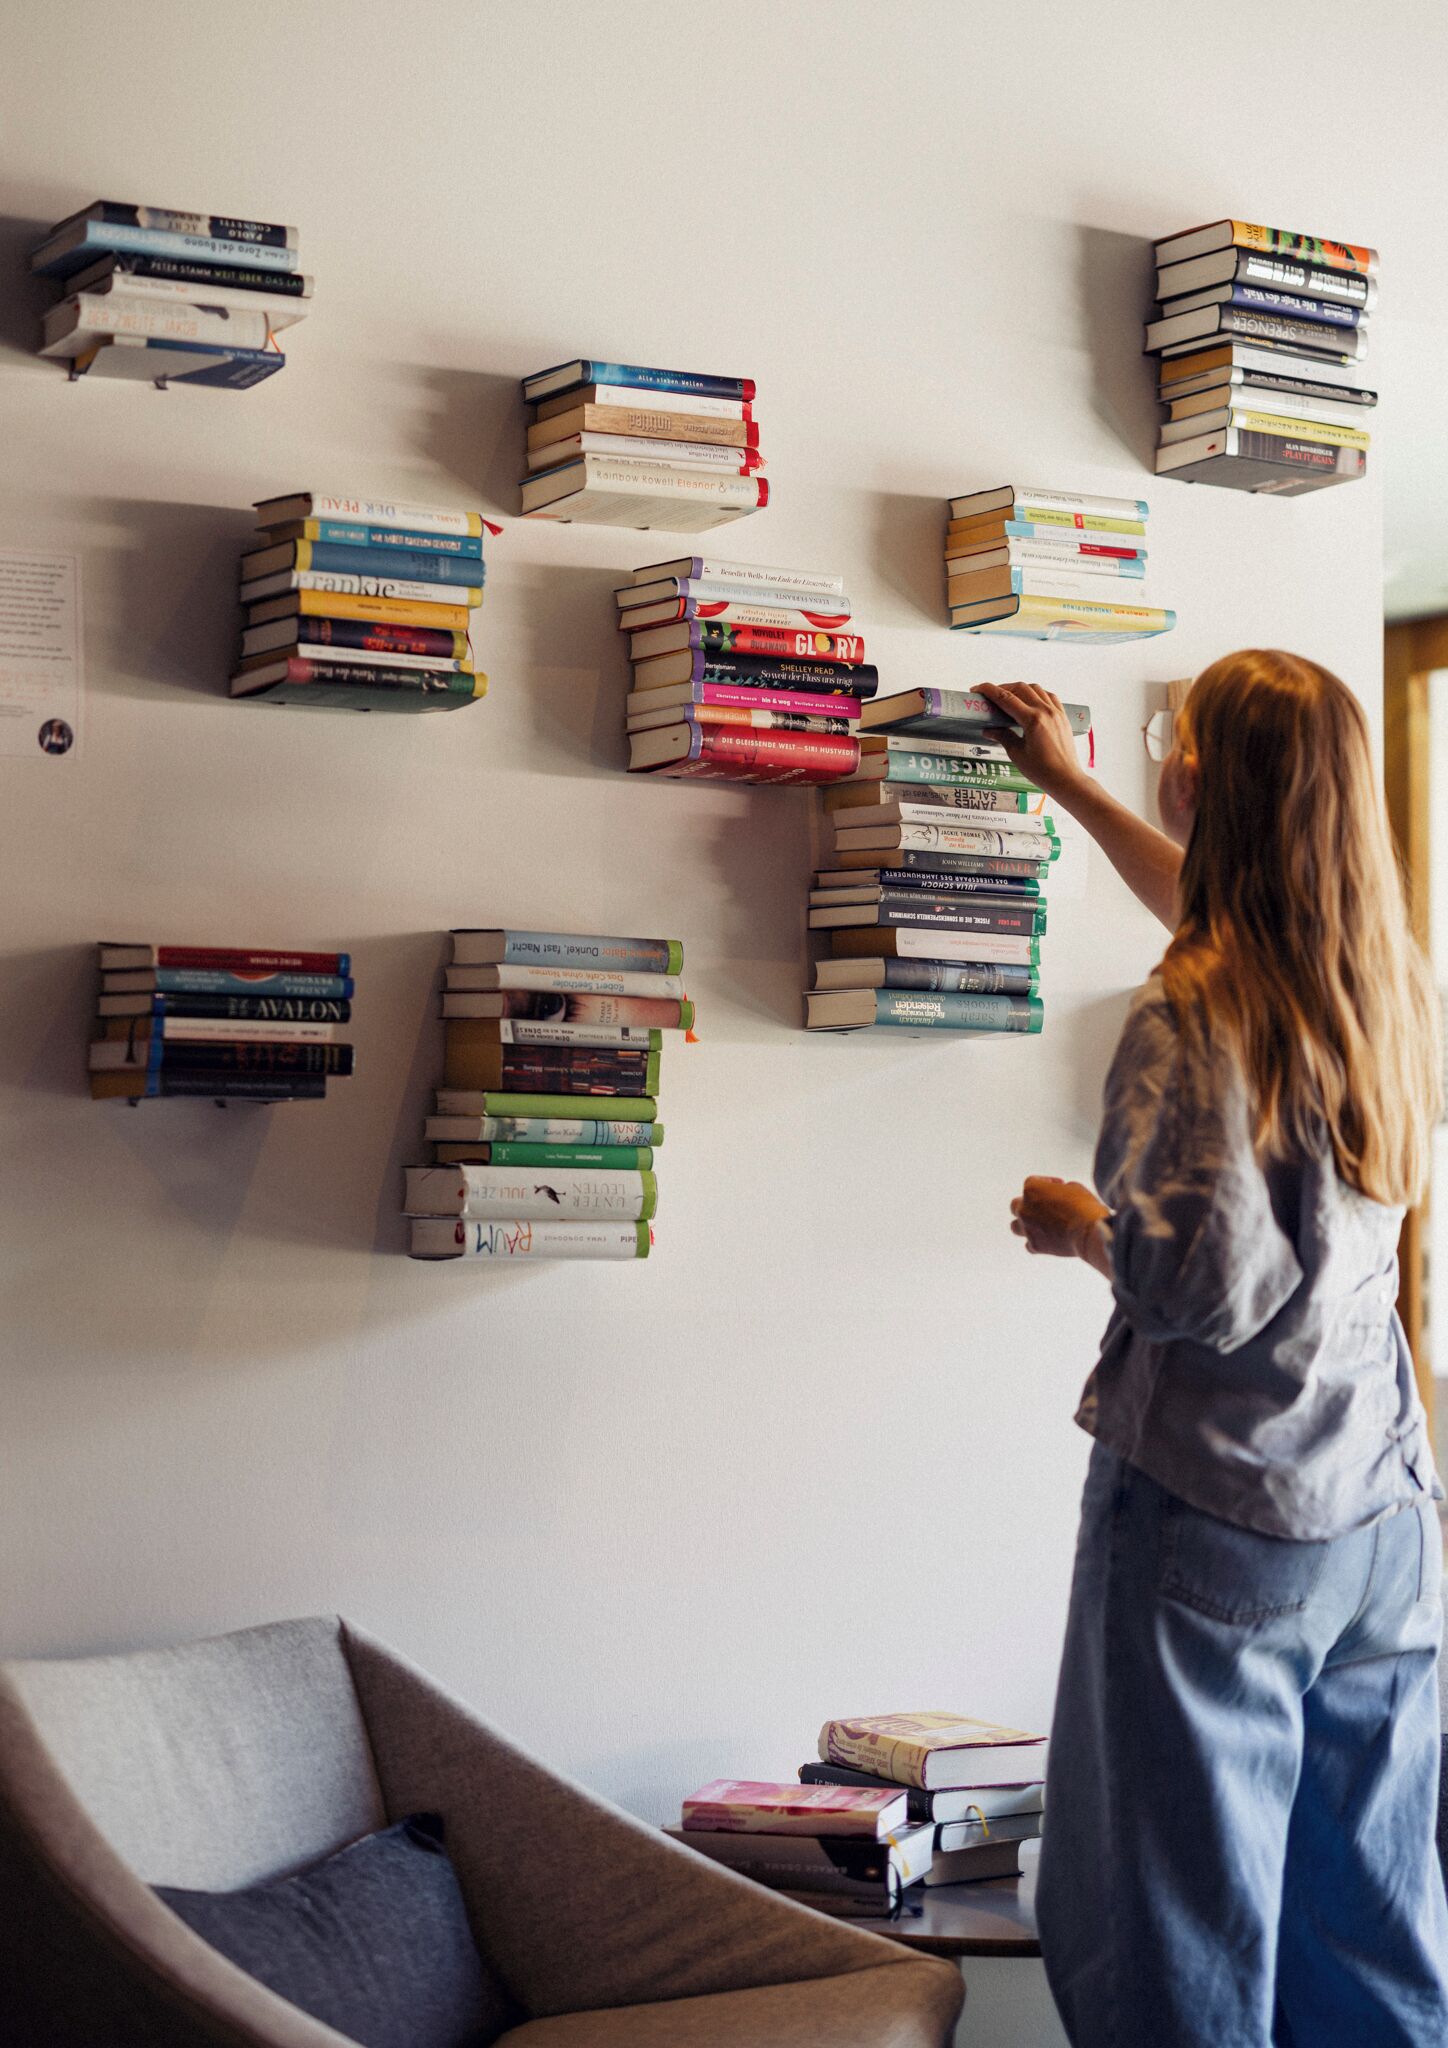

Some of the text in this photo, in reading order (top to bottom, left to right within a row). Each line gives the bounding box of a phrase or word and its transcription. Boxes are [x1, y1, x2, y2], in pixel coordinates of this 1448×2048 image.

[218, 218, 272, 235] COGNETTI
[228, 228, 263, 242] PAOLO
[236, 243, 261, 259] Zora
[149, 258, 181, 274] PETER
[180, 262, 212, 278] STAMM
[214, 266, 236, 280] WEIT
[1243, 288, 1265, 301] Wals
[1265, 291, 1280, 303] des
[1280, 296, 1301, 310] Tage
[1300, 300, 1317, 312] Die
[1232, 316, 1297, 341] SPRENGER
[638, 374, 705, 388] Alle sieben Wellen
[1294, 424, 1308, 434] DIE
[1284, 443, 1300, 451] ALAN
[710, 452, 730, 461] David
[1303, 452, 1311, 460] IT
[597, 470, 728, 494] Rainbow Rowell Eleanor &
[321, 496, 397, 518] DER PFAU
[1048, 554, 1066, 564] Leben
[720, 567, 748, 579] Benedict
[747, 570, 764, 581] Wells
[777, 574, 793, 585] Ende
[776, 592, 831, 606] ELENA FERRANTE
[764, 617, 792, 627] JOHANNA
[751, 628, 786, 641] NOVIOLET
[750, 639, 788, 652] BULAWAYO
[335, 667, 377, 683] Marie des
[780, 663, 835, 676] SHELLEY READ
[760, 669, 854, 687] So weit der Fluss uns trägt
[716, 693, 741, 702] Christoph
[761, 696, 772, 704] hin
[780, 698, 791, 708] weg
[794, 700, 815, 708] Verliebe
[721, 736, 735, 745] DIE
[735, 738, 776, 750] GLEISSENDE
[777, 743, 798, 752] WELT
[803, 745, 856, 758] SIRI HUSTVEDT
[908, 755, 1011, 778] NINCSHOF
[919, 771, 997, 786] JOHANNA SEBAUER
[902, 788, 929, 798] was ist
[953, 788, 997, 801] SALTER
[955, 799, 997, 811] JAMES
[940, 829, 960, 837] JACKIE
[941, 858, 984, 869] JOHN WILLIAMS
[884, 869, 1009, 886] DAS LIEBESPAAR DES JAHRHUNDERTS
[920, 880, 978, 892] JULIA SCHOCH
[964, 915, 973, 924] DIE
[972, 915, 991, 926] FISCHE,
[511, 941, 628, 959] Bator Dunkel, fast Nacht
[527, 967, 624, 983] Das Café ohne Namen
[284, 985, 329, 997] ANDREA
[551, 979, 625, 993] Robert Seethaler
[258, 998, 343, 1021] AVALON
[894, 1000, 941, 1014] Reisenden
[955, 999, 1001, 1014] Brooks
[898, 1015, 936, 1026] Handbuch
[959, 1012, 996, 1025] Sarah
[515, 1025, 543, 1036] DENKST
[554, 1034, 571, 1043] DEIN
[612, 1123, 646, 1136] SUNGS
[617, 1133, 652, 1146] LADEN
[467, 1186, 527, 1200] JULI ZEH
[571, 1181, 627, 1196] LEUTEN
[572, 1195, 626, 1208] UNTER
[474, 1221, 532, 1255] RAUM
[586, 1235, 608, 1243] EMMA
[763, 1861, 849, 1876] BARACK OBAMA
